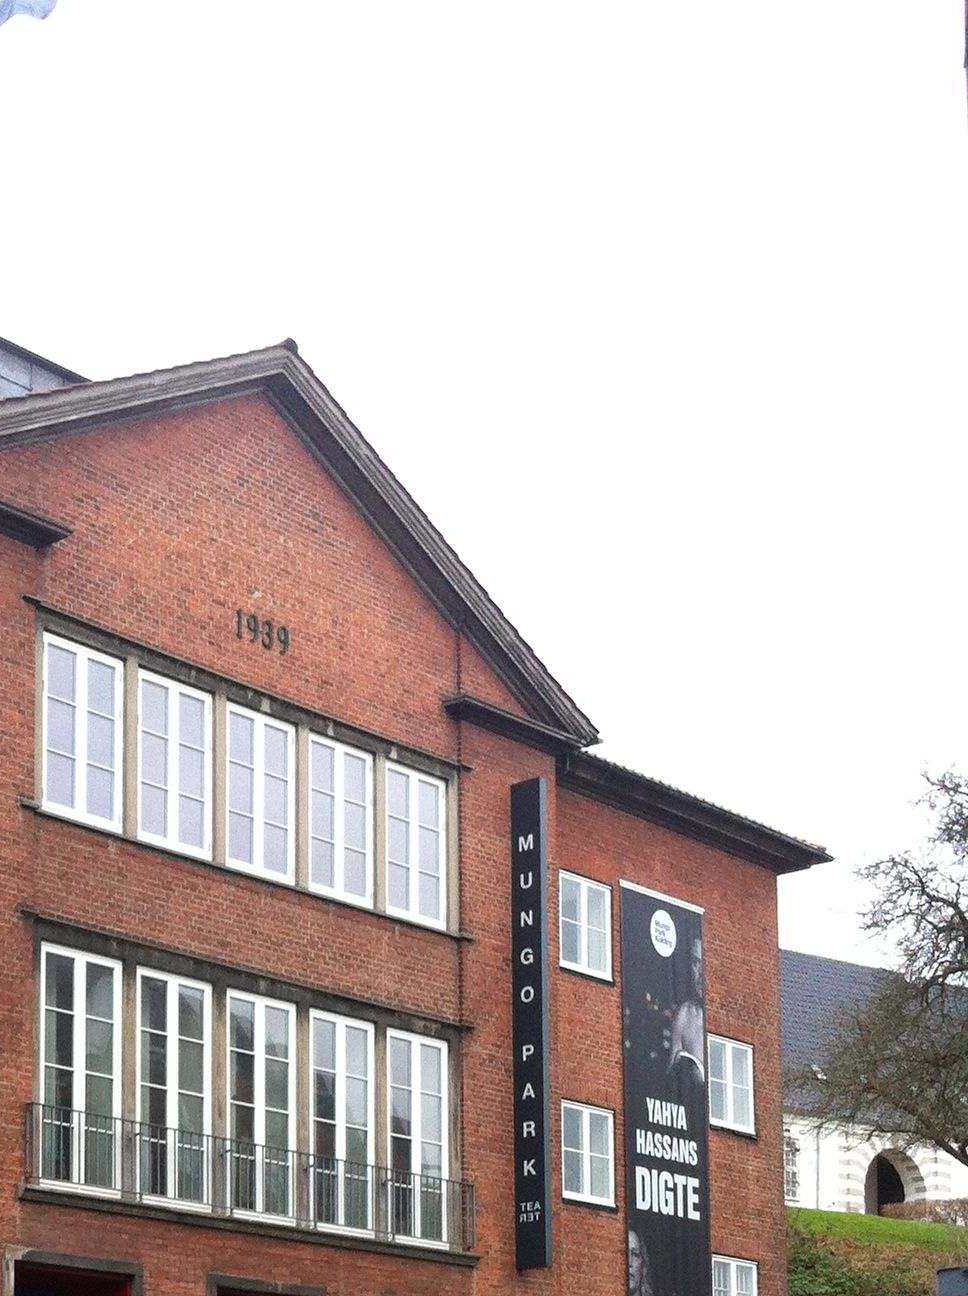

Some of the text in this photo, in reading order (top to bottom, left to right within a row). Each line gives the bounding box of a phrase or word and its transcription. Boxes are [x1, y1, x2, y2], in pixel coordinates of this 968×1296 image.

[236, 608, 290, 656] 1939
[518, 834, 536, 1176] MUNGO PARK
[646, 1097, 687, 1131] YAHYA
[636, 1128, 698, 1166] HASSANS
[520, 1200, 541, 1212] TEA
[635, 1165, 700, 1221] DIGTE
